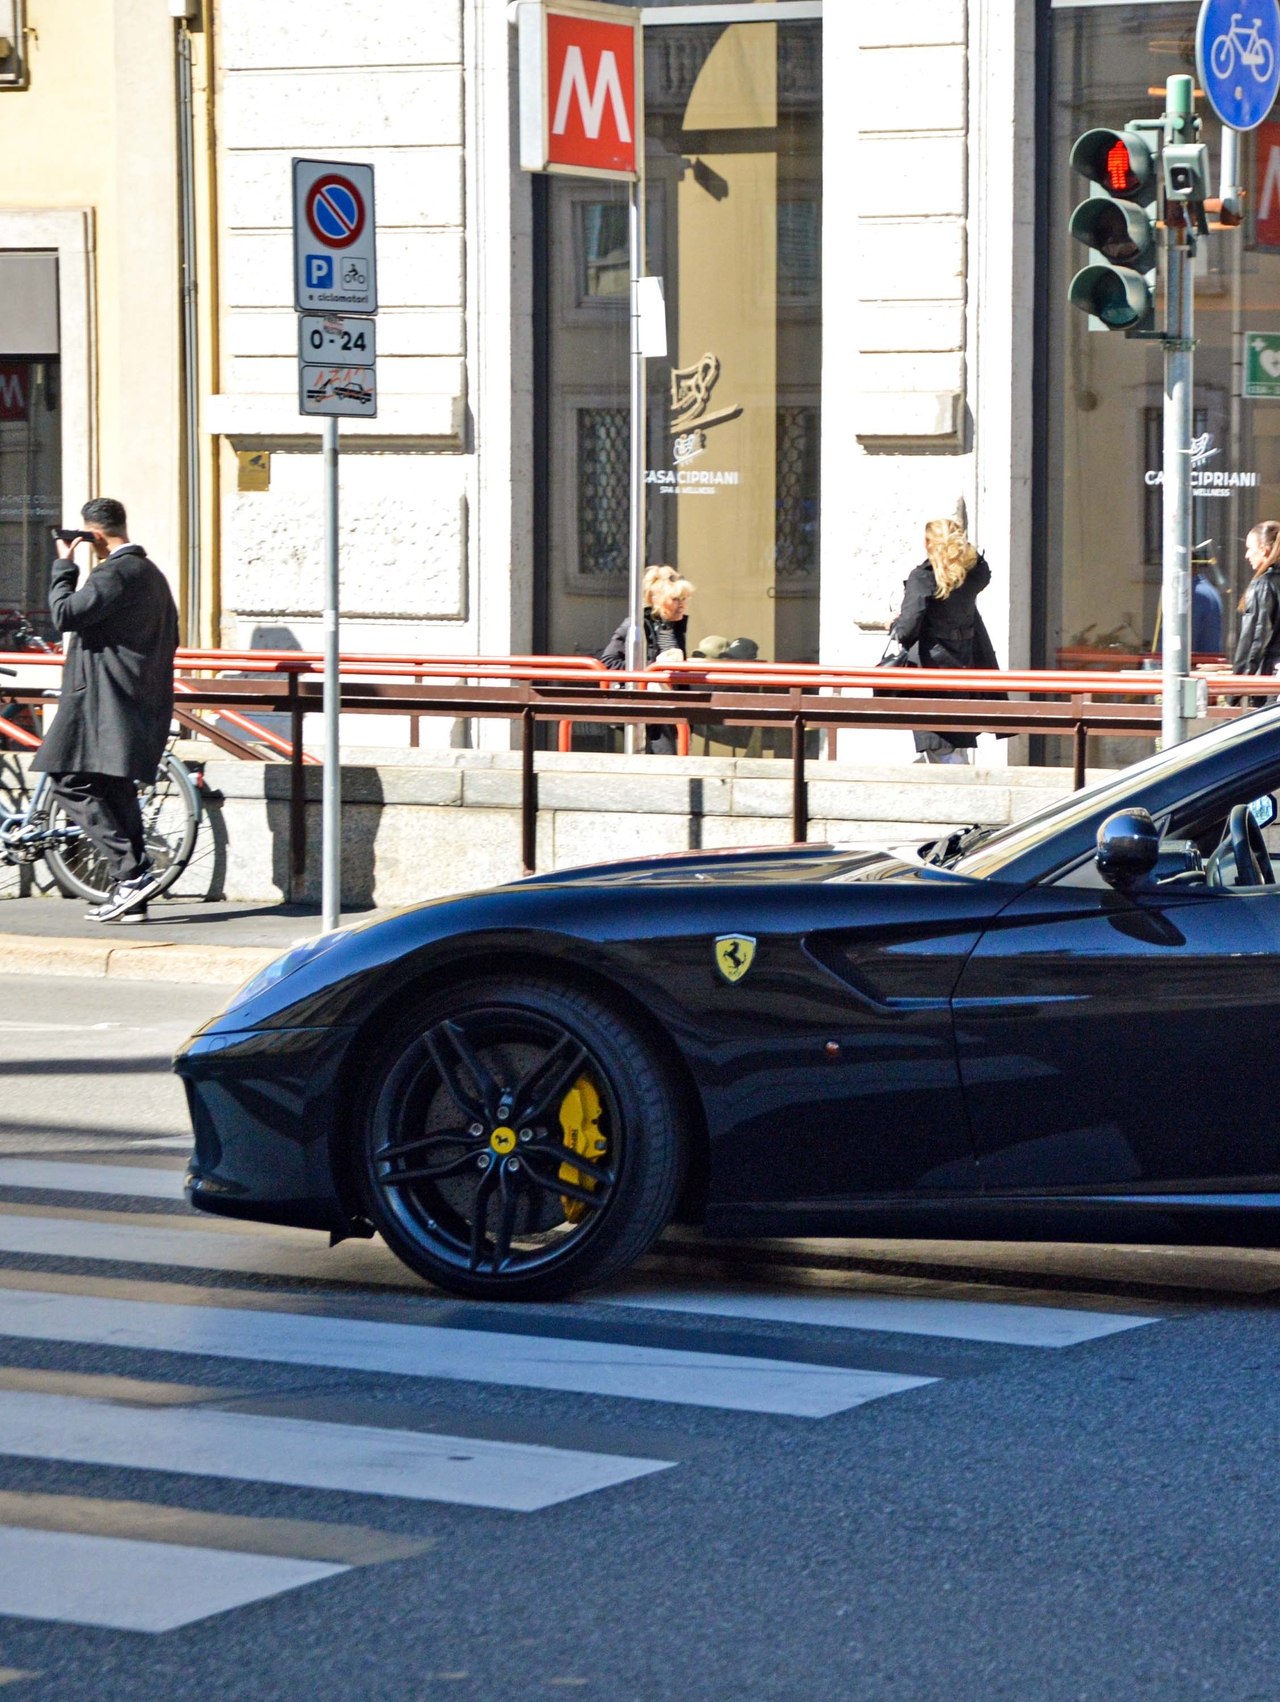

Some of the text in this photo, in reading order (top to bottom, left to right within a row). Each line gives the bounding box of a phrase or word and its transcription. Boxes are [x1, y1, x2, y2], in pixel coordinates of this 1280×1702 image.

[552, 45, 632, 143] M
[311, 259, 328, 284] P
[677, 471, 739, 485] CIPRIANI
[1190, 472, 1256, 486] CIPRIANI
[1192, 488, 1230, 497] WELLNESS
